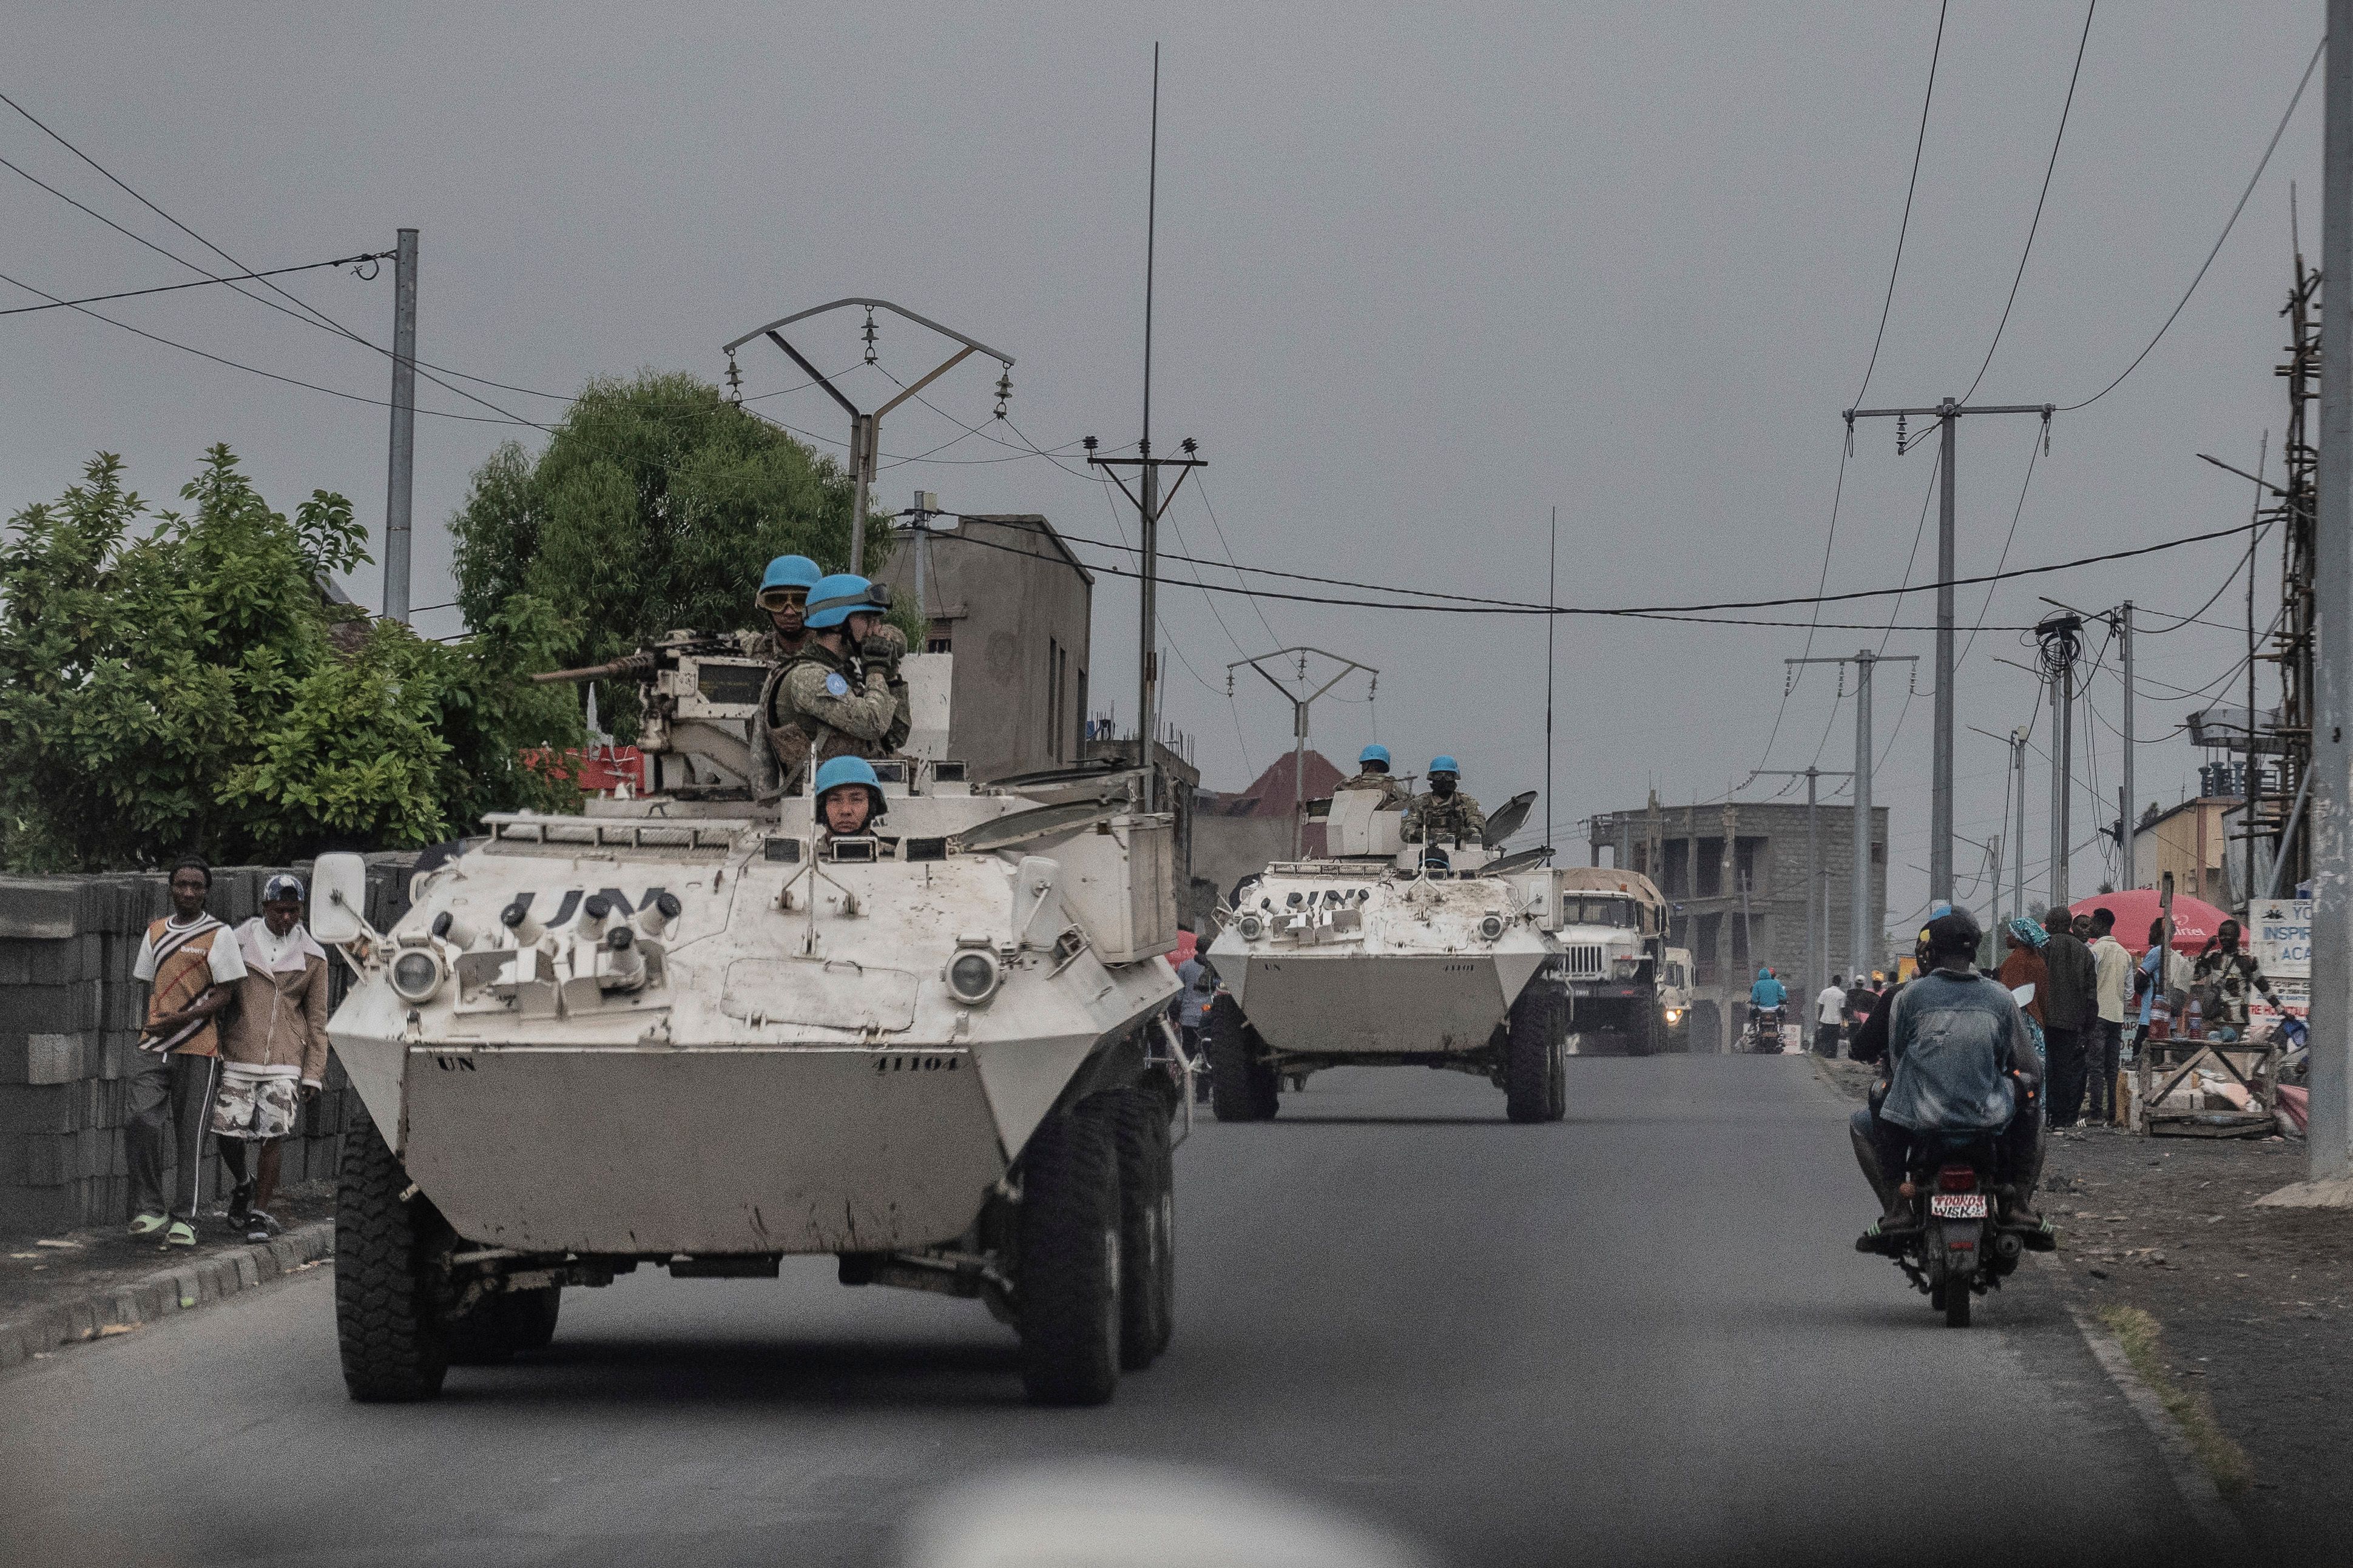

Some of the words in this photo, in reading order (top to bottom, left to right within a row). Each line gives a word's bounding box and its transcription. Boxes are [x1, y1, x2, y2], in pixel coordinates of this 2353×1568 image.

[1286, 889, 1356, 909] UN
[510, 887, 666, 929] UN
[2174, 926, 2207, 936] irtel
[437, 1057, 476, 1072] UN
